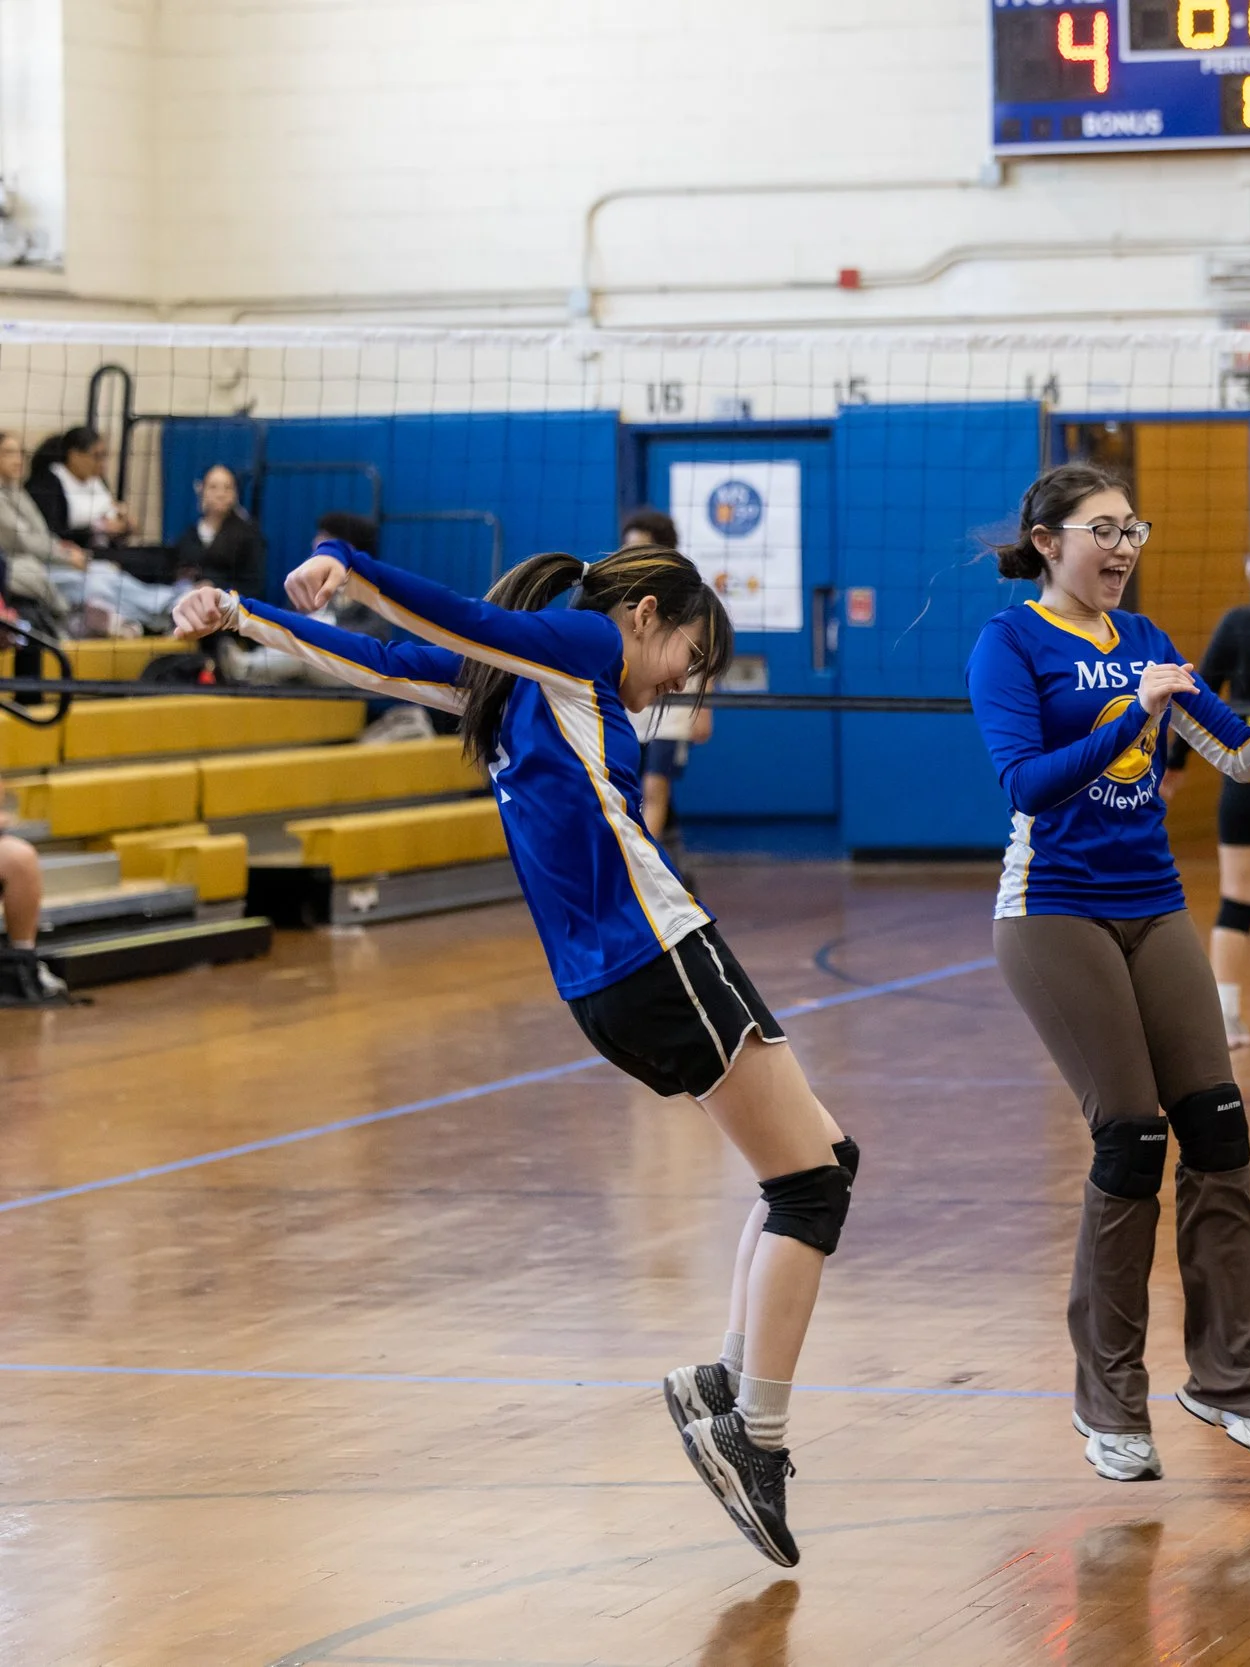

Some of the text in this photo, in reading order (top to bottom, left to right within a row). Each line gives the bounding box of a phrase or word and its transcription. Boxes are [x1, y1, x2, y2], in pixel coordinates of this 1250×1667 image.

[1057, 11, 1110, 94] 4
[1082, 109, 1163, 138] BONUS
[647, 379, 684, 415] 16
[1074, 660, 1129, 691] MS
